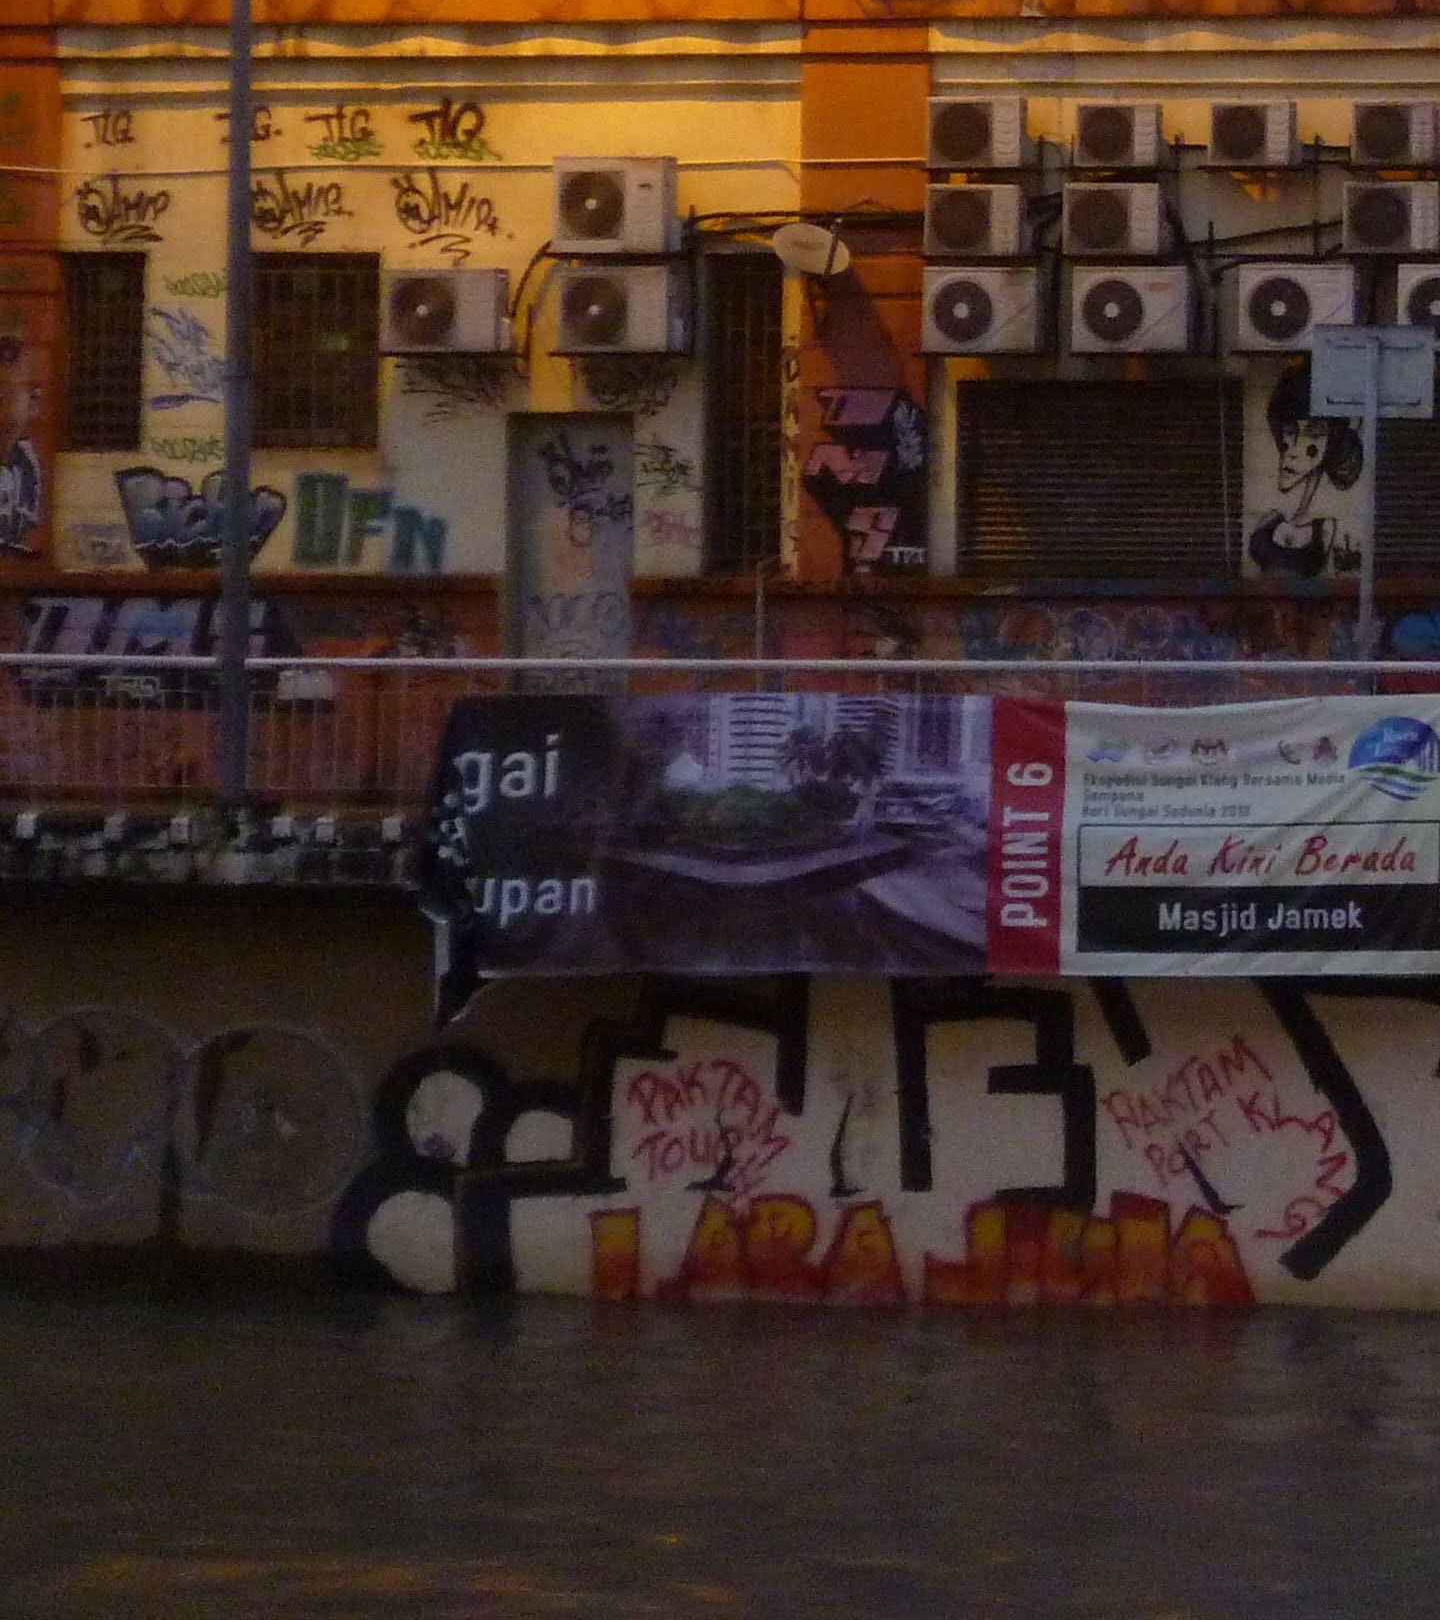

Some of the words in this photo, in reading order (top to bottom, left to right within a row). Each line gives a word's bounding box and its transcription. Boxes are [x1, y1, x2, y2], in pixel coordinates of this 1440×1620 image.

[1006, 759, 1053, 788] 6
[999, 803, 1050, 930] POINT
[1104, 833, 1190, 877] Anda
[1206, 833, 1284, 878] Kini
[1294, 833, 1417, 877] Berada
[1157, 900, 1257, 940] Masjid
[1266, 900, 1364, 932] Jamek
